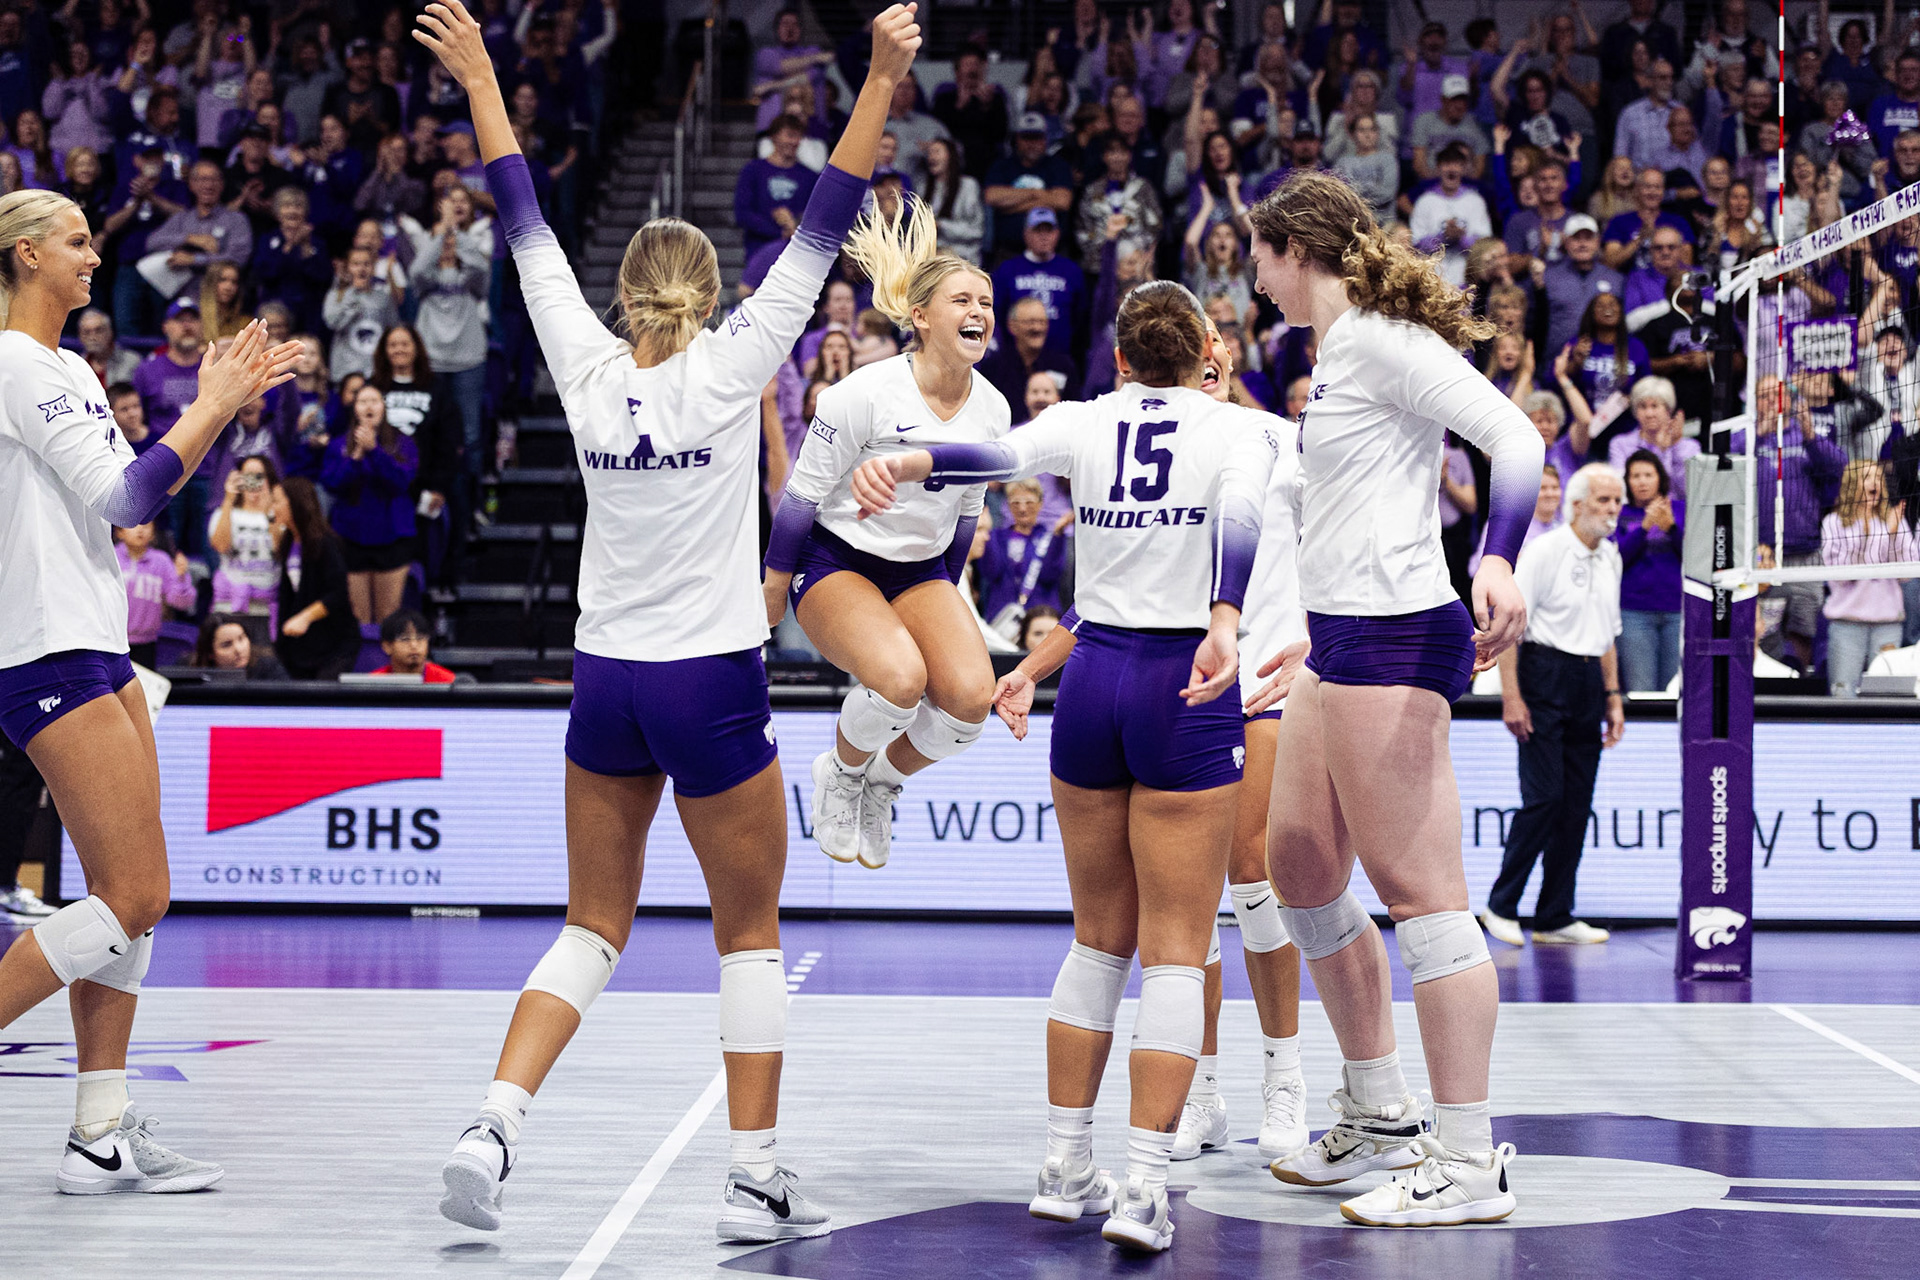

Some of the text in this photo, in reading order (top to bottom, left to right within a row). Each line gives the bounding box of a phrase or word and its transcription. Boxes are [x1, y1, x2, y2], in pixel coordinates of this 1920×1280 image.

[583, 447, 713, 471] WILDCATS
[1109, 420, 1179, 502] 15
[1079, 506, 1208, 529] WILDCATS
[327, 808, 441, 850] BHS
[1708, 766, 1729, 894] sports imports
[1812, 799, 1878, 851] to
[203, 867, 442, 885] CONSTRUCTION
